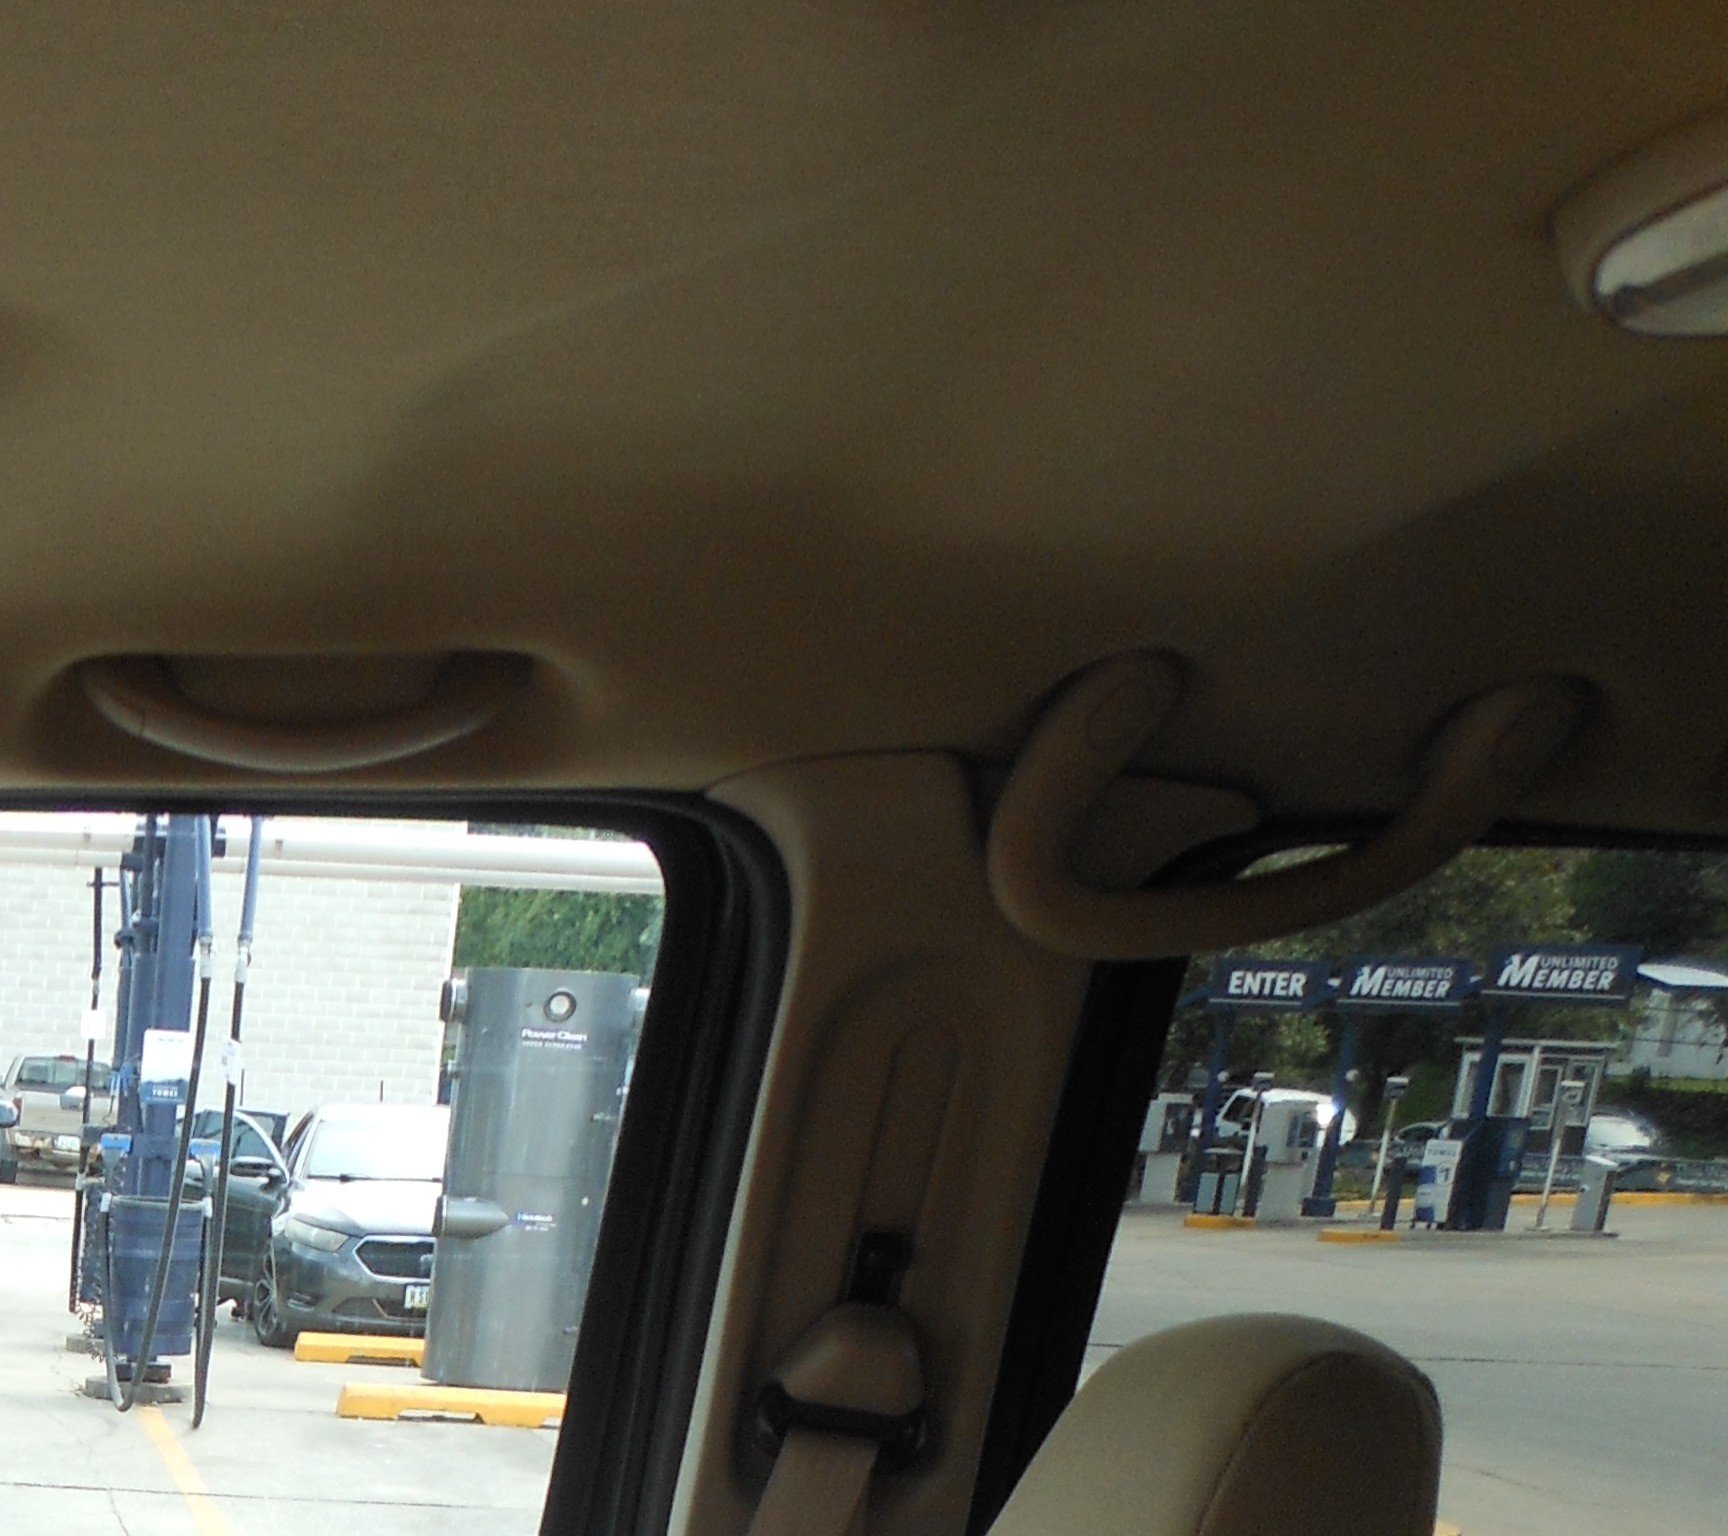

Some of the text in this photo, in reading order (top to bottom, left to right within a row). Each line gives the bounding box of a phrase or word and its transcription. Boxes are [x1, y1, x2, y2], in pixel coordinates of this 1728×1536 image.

[1386, 966, 1454, 979] UNLIMITED
[1497, 953, 1616, 991] MEMBER
[1539, 955, 1620, 970] UNLIMITED
[1228, 970, 1308, 998] ENTER
[1349, 965, 1452, 998] MEMBER
